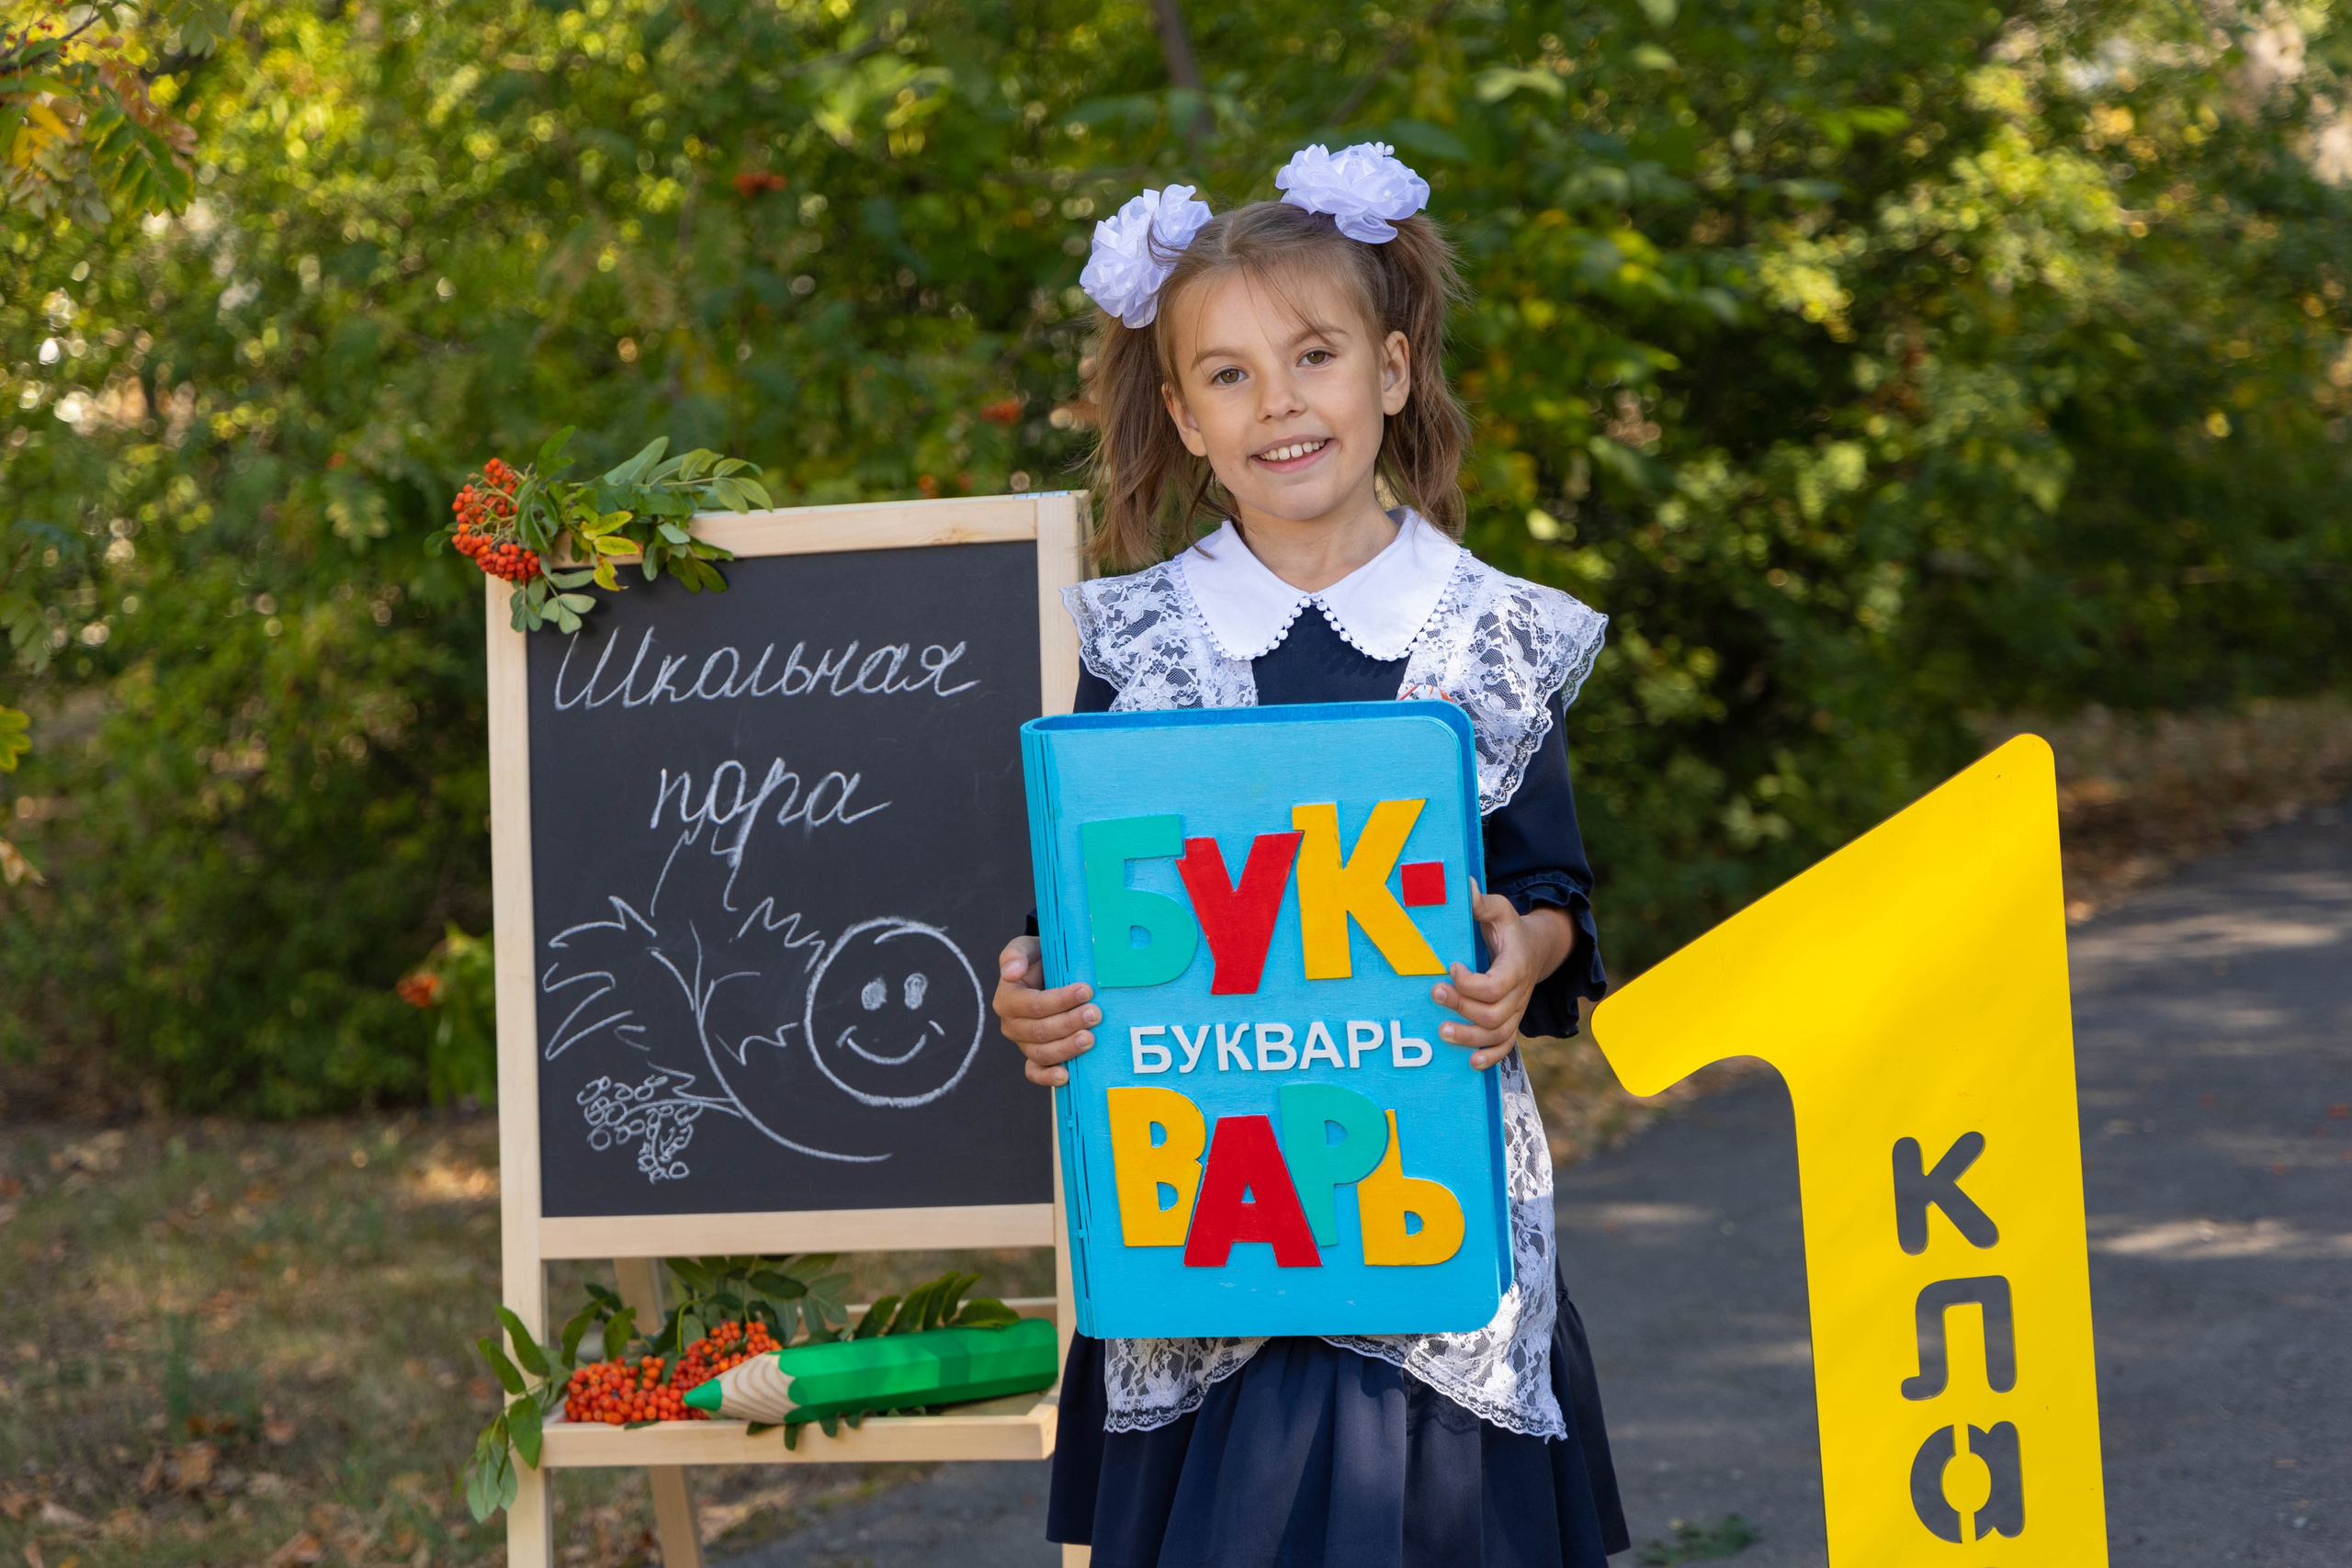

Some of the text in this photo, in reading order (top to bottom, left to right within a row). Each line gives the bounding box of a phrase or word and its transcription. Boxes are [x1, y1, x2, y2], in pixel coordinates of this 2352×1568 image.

[554, 626, 980, 710] Школьная
[650, 758, 891, 867] пора
[1080, 797, 1449, 995] БУК-
[1129, 1020, 1433, 1074] БУКВАРЬ
[1106, 1082, 1465, 1268] ВАРЬ
[1590, 733, 2109, 1568] 1
